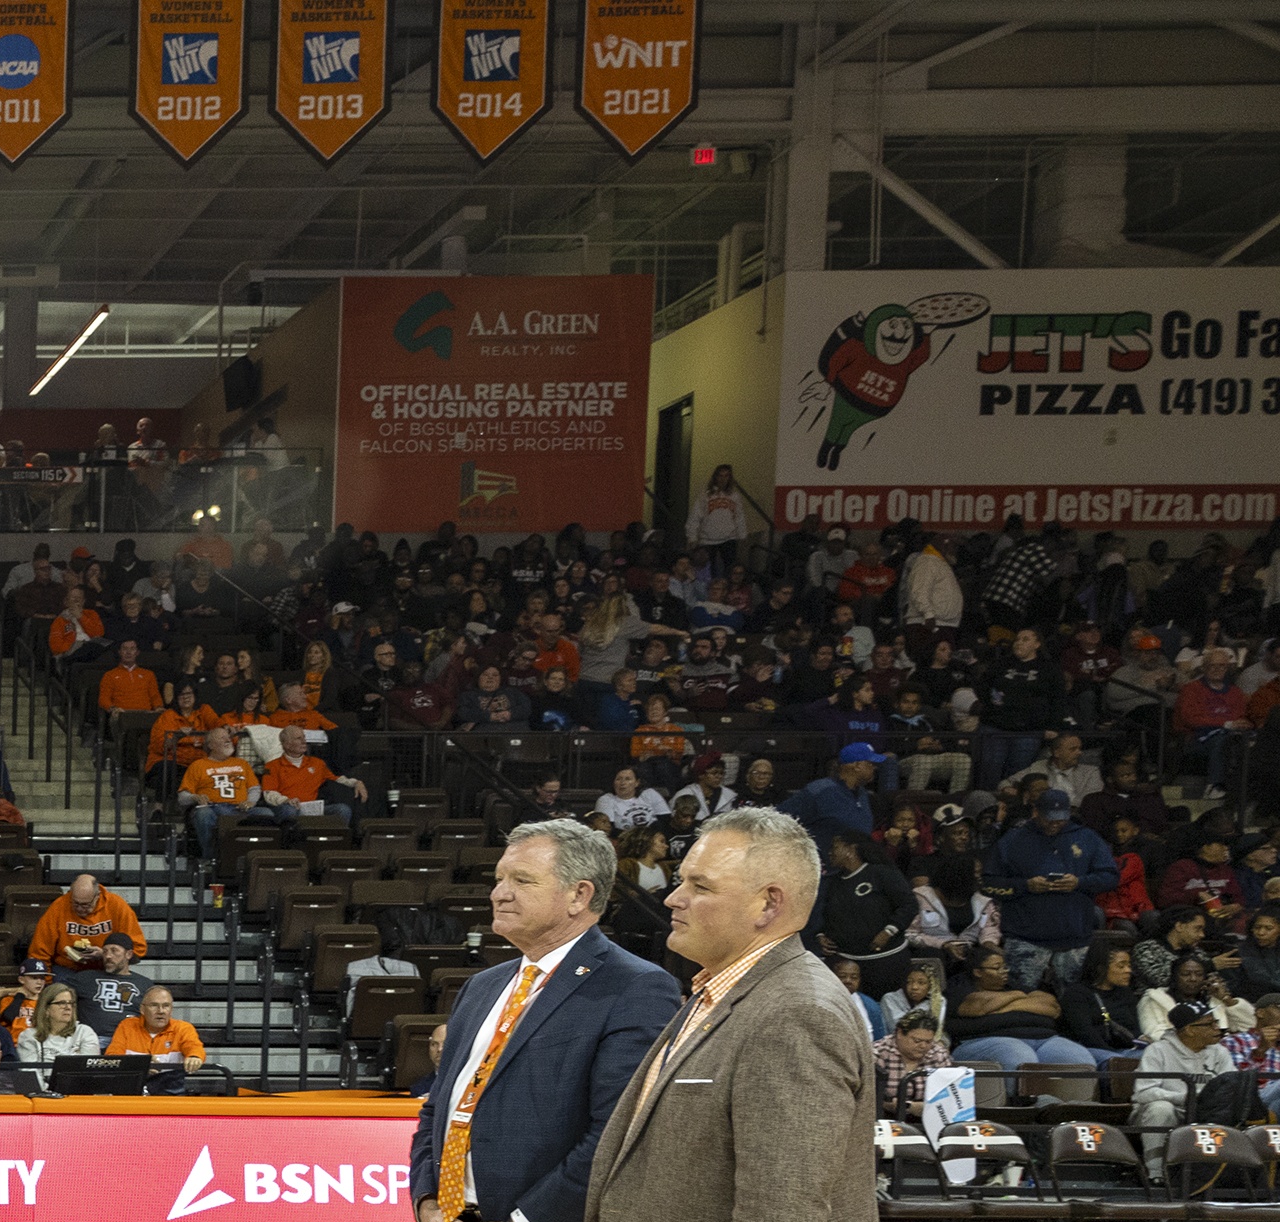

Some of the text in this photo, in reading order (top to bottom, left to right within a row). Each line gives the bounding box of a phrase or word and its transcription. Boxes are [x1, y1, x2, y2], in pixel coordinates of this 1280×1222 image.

[150, 12, 232, 25] BASKETBALL
[291, 9, 375, 23] BASKETBALL
[592, 34, 688, 70] WNIT
[157, 96, 221, 120] 2012
[298, 94, 364, 120] 2013
[457, 92, 523, 118] 2014
[603, 88, 671, 116] 2021
[467, 310, 600, 336] A.A. GREEN
[976, 311, 1152, 373] JET'S
[1161, 310, 1222, 359] Go
[360, 382, 628, 402] OFFICIAL REAL ESTATE
[856, 381, 890, 402] PIZZA
[861, 369, 897, 392] JET'S
[979, 383, 1145, 415] PIZZA
[1160, 378, 1251, 415] (419)
[371, 400, 614, 419] & HOUSING PARTNER
[379, 420, 605, 436] OF BGSU ATHLETICS AND
[360, 436, 624, 453] FALCON SPORTS PROPERTIES
[41, 470, 54, 481] 115
[56, 470, 63, 481] C
[785, 487, 1277, 524] Order Online at JetsPizza.com
[66, 919, 112, 935] BGSU
[244, 1163, 354, 1203] BSN
